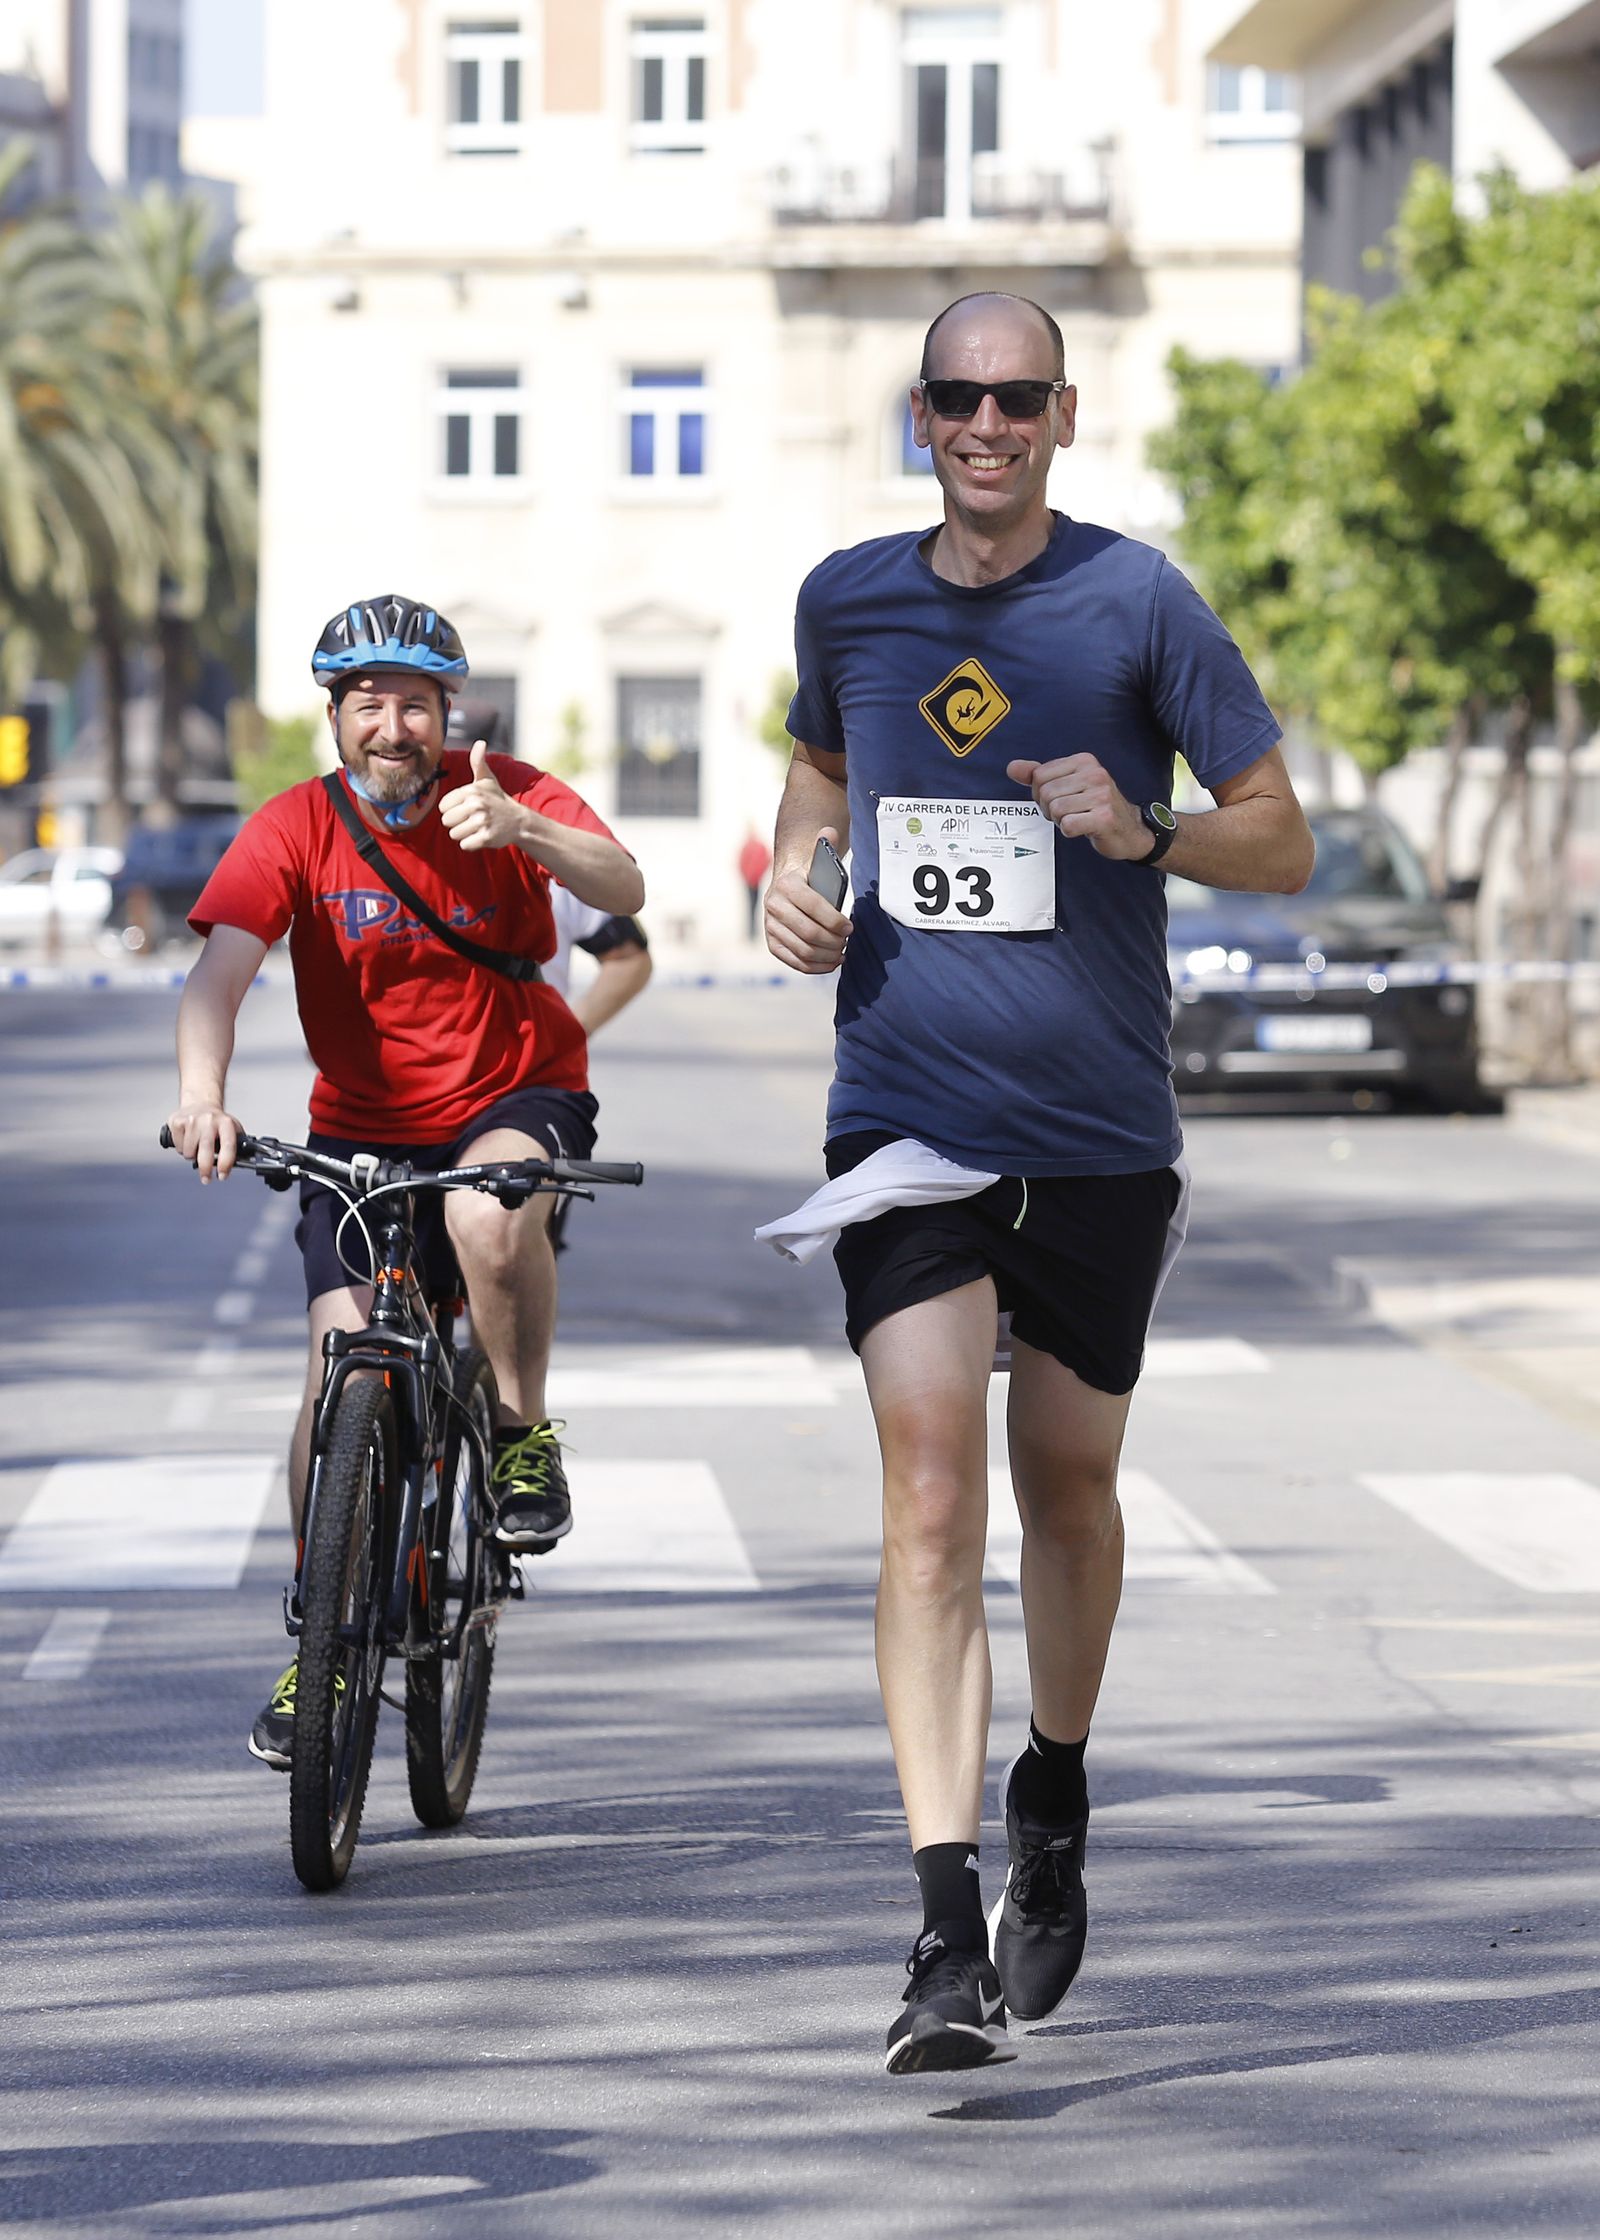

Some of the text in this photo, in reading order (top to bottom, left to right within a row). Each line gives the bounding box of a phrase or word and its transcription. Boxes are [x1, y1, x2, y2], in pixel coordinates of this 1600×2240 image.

[884, 803, 1040, 817] IV CARRERA DE LA PRENSA
[940, 818, 970, 833] APM
[912, 864, 994, 918] 93
[313, 888, 497, 941] Pais
[915, 917, 945, 925] CABRERA
[381, 930, 438, 947] FRANC
